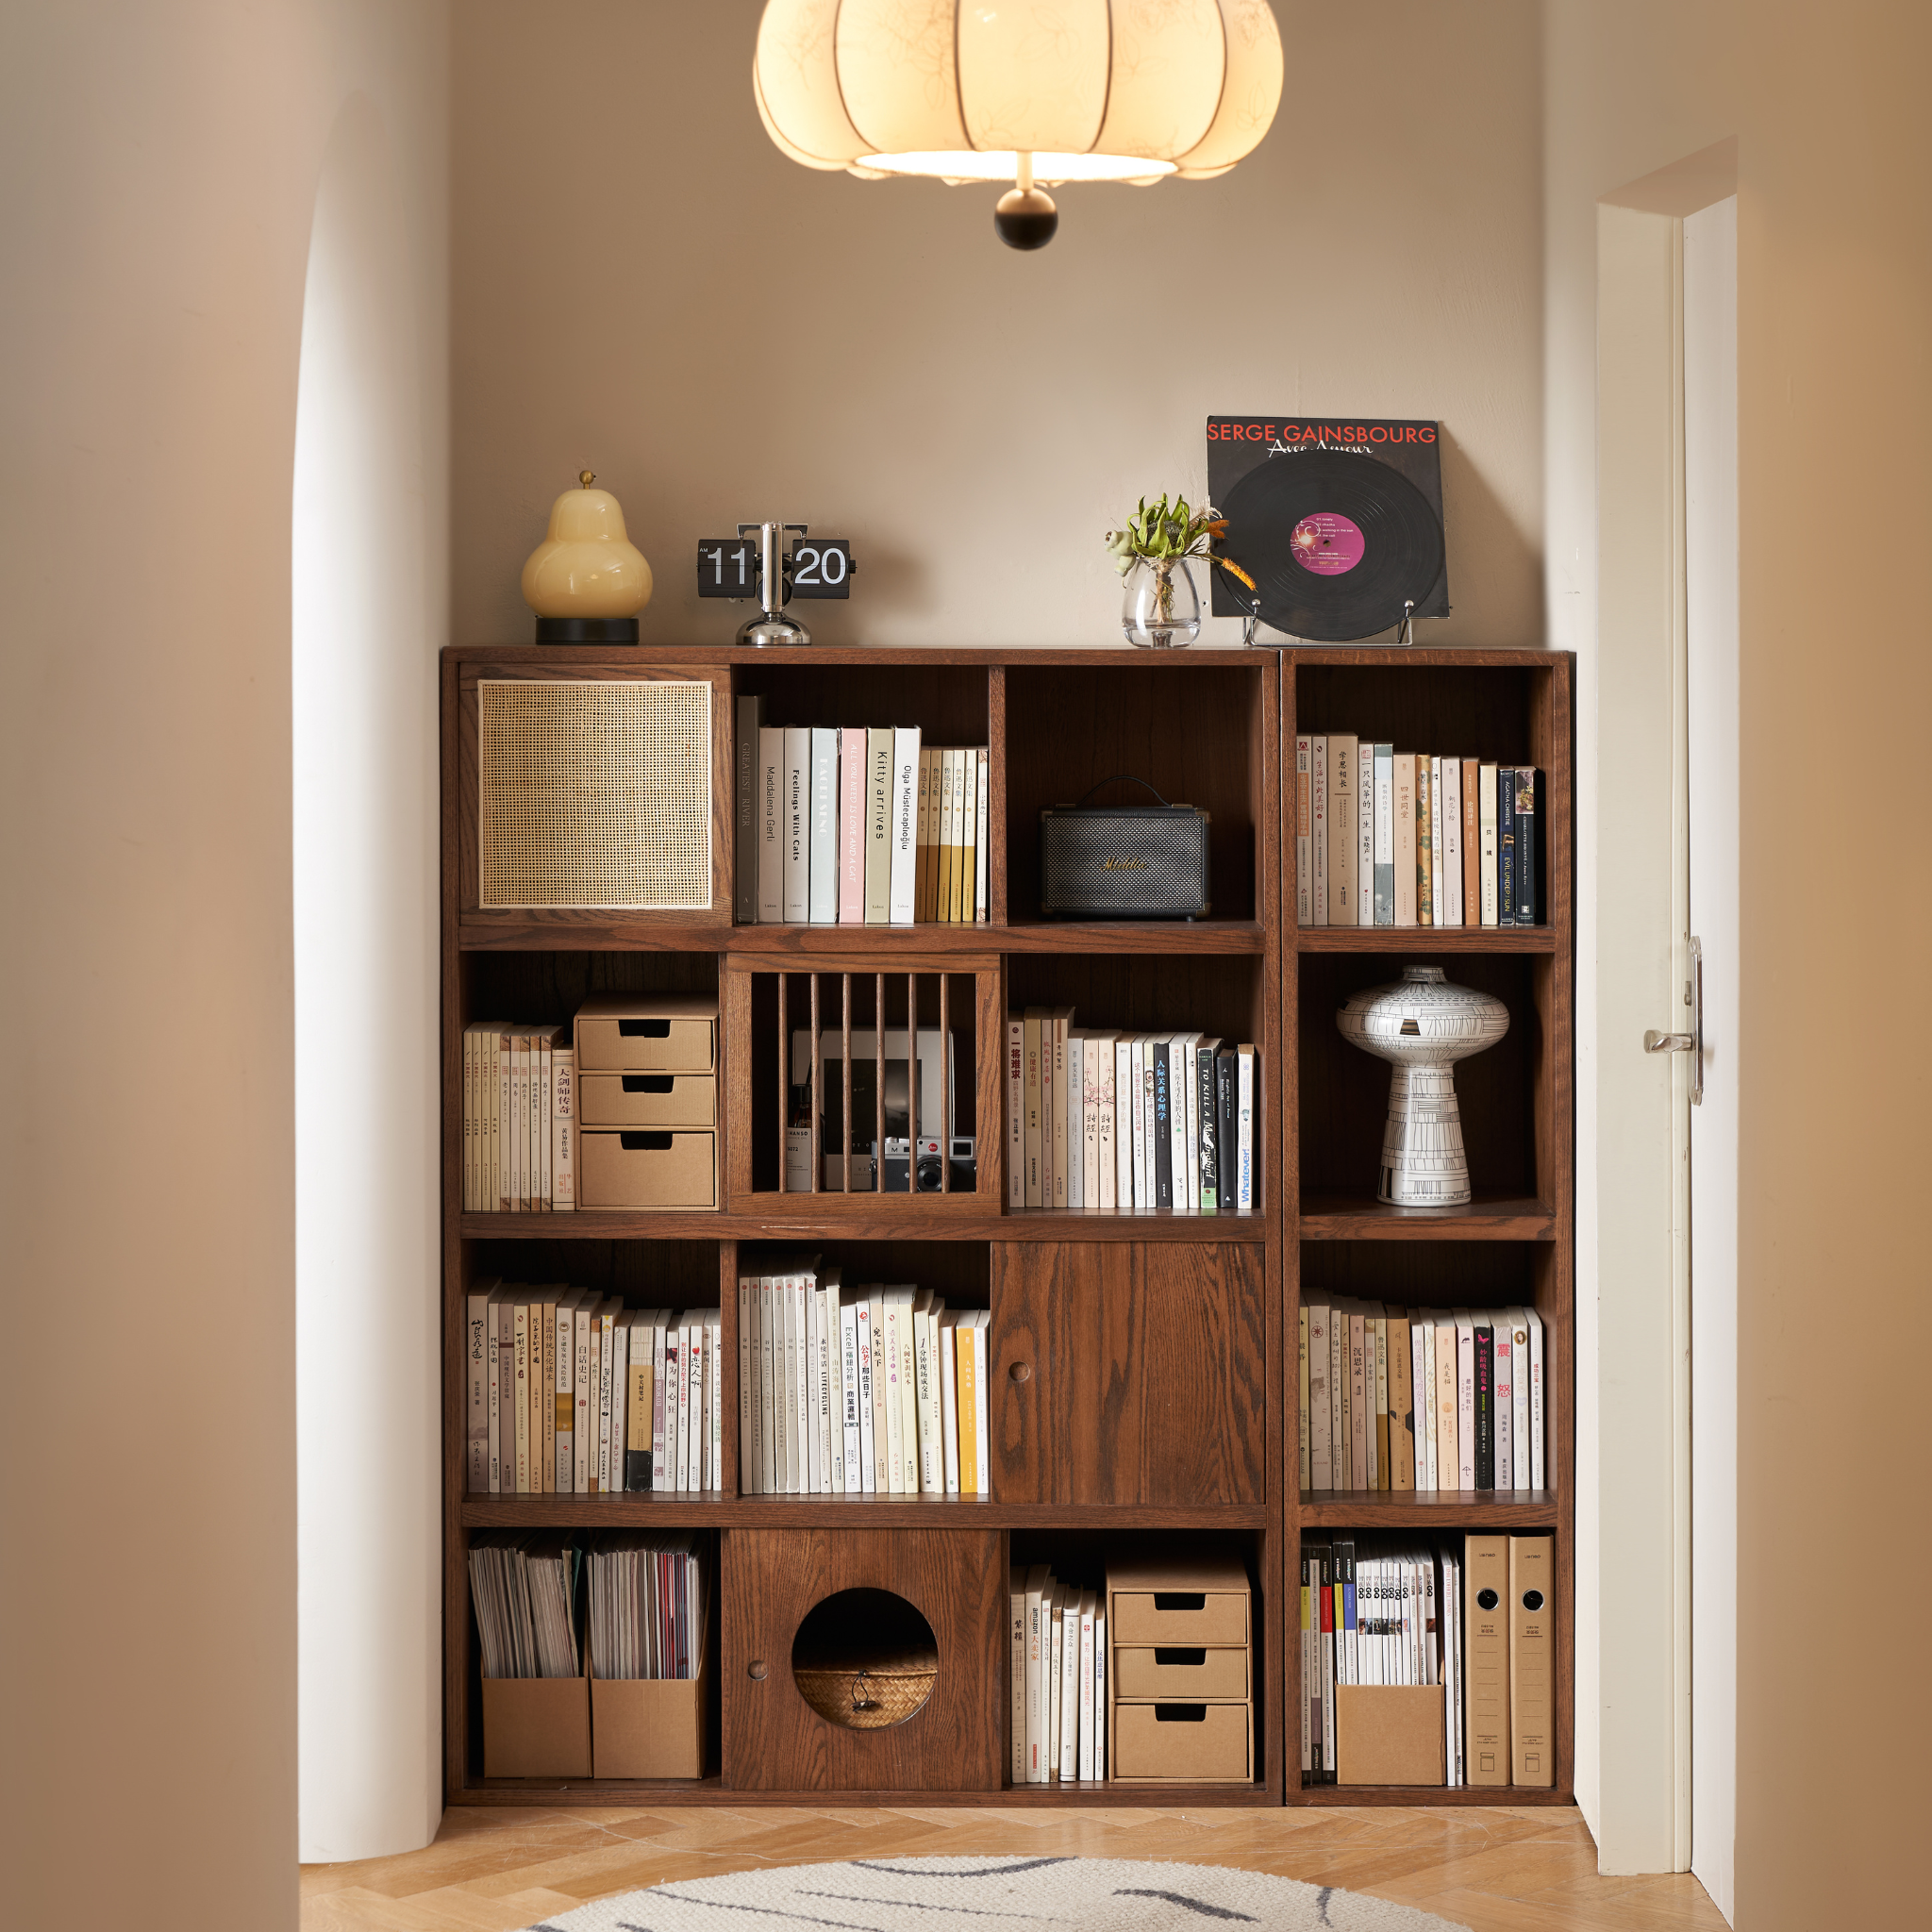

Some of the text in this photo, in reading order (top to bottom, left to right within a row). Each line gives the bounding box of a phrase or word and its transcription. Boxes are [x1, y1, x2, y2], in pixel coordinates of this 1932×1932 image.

[1208, 424, 1436, 443] SERGE GAINSBOURG
[708, 547, 745, 585] 11
[794, 547, 846, 585] 20
[741, 742, 751, 827] GREATEST RIVER
[902, 765, 912, 784] Olga
[1338, 751, 1347, 789] 学思相长
[766, 766, 775, 842] Maddalena Gerli
[791, 769, 800, 810] Feelings
[874, 751, 888, 840] Kitty arrives
[1361, 762, 1372, 829] 一只风筝的一生
[1400, 786, 1409, 819] 四世同堂
[849, 813, 858, 835] LOVE
[850, 805, 858, 813] IS
[849, 837, 858, 860] AND
[1010, 1041, 1021, 1080] 一将难求
[1202, 1068, 1209, 1081] TO
[557, 1068, 571, 1114] 大剑师传奇
[1157, 1059, 1167, 1121] 人际关系心理学
[1086, 1112, 1098, 1133] 詩經
[1100, 1112, 1112, 1133] 詩經
[1241, 1148, 1250, 1203] Whatever!
[545, 1317, 554, 1381] 中国传统文化读本
[845, 1326, 854, 1349] Excel
[1377, 1336, 1386, 1366] 鲁迅文集
[578, 1345, 588, 1384] 白话史记
[691, 1356, 702, 1389] 恋人啊
[919, 1338, 929, 1400] 1分钟现场成交法
[1353, 1347, 1363, 1376] 沉思录
[1479, 1348, 1489, 1385] 妙龄吸血鬼
[1496, 1342, 1511, 1398] 震怒
[667, 1366, 676, 1414] 为你心狂
[1358, 1587, 1365, 1599] GQ
[1365, 1587, 1372, 1599] GQ
[1374, 1587, 1380, 1599] GQ
[1381, 1588, 1389, 1600] GQ
[1389, 1587, 1394, 1599] GQ
[1395, 1589, 1401, 1600] GQ
[1403, 1587, 1408, 1599] GQ
[1426, 1585, 1433, 1597] GQ
[1030, 1635, 1040, 1661] 大卖家
